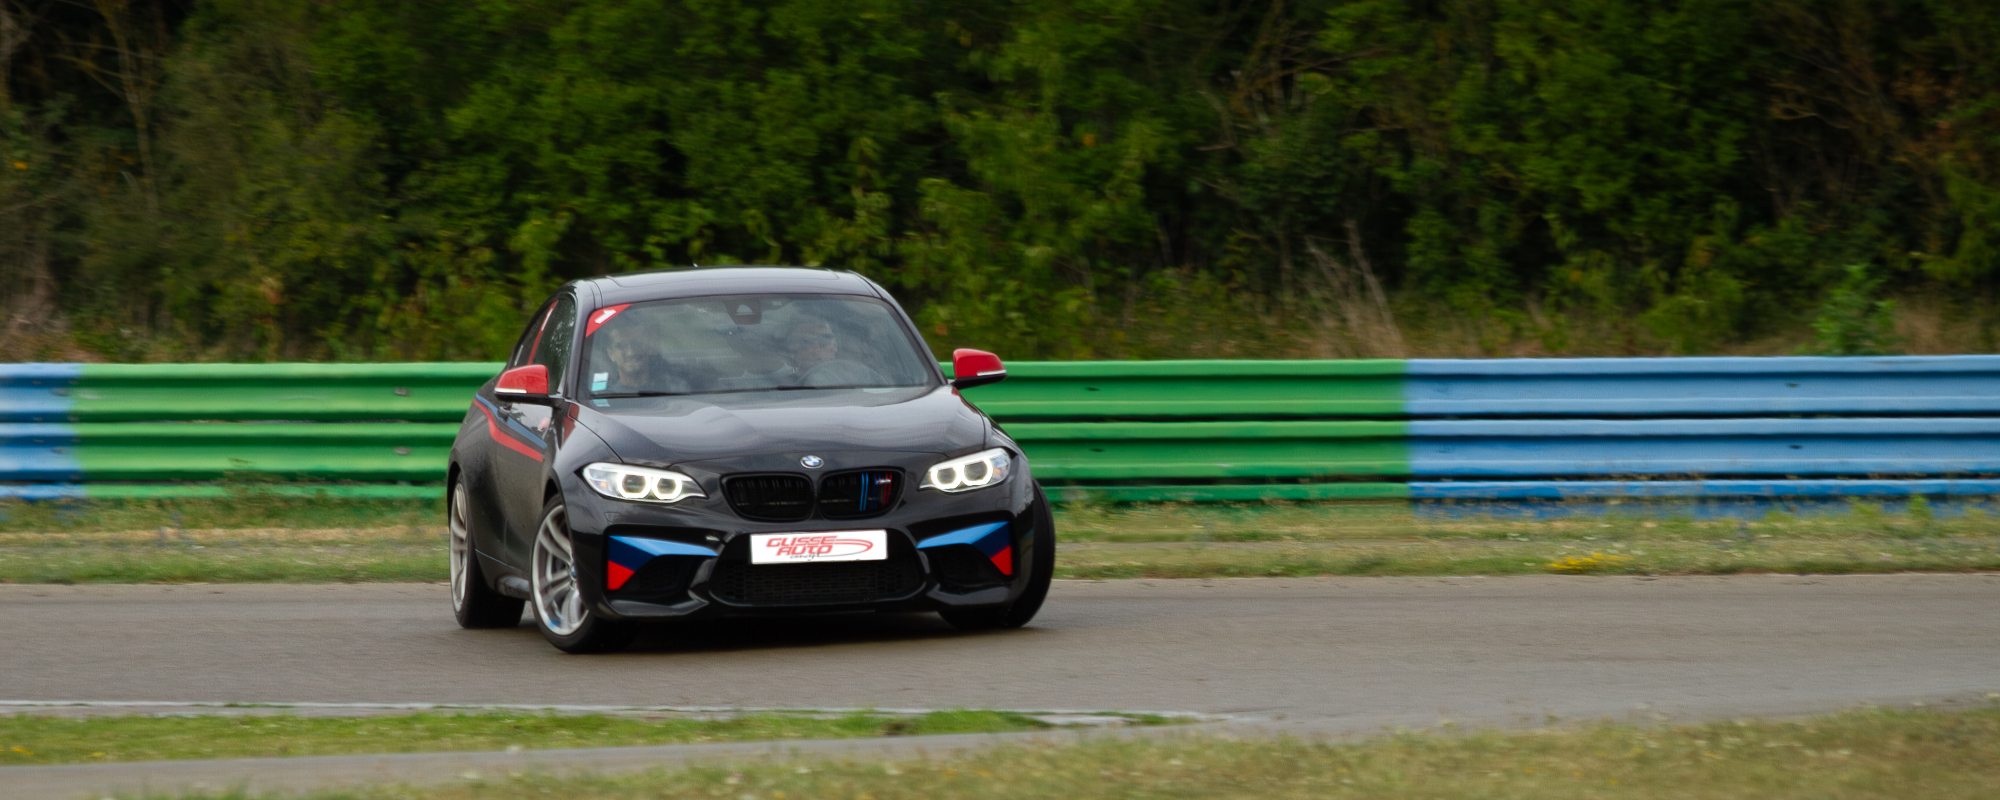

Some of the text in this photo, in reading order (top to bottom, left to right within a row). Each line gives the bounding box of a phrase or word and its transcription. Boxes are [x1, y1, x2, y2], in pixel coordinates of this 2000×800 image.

[594, 309, 617, 324] 1
[766, 536, 837, 547] GLISSE
[776, 545, 833, 556] AUTO
